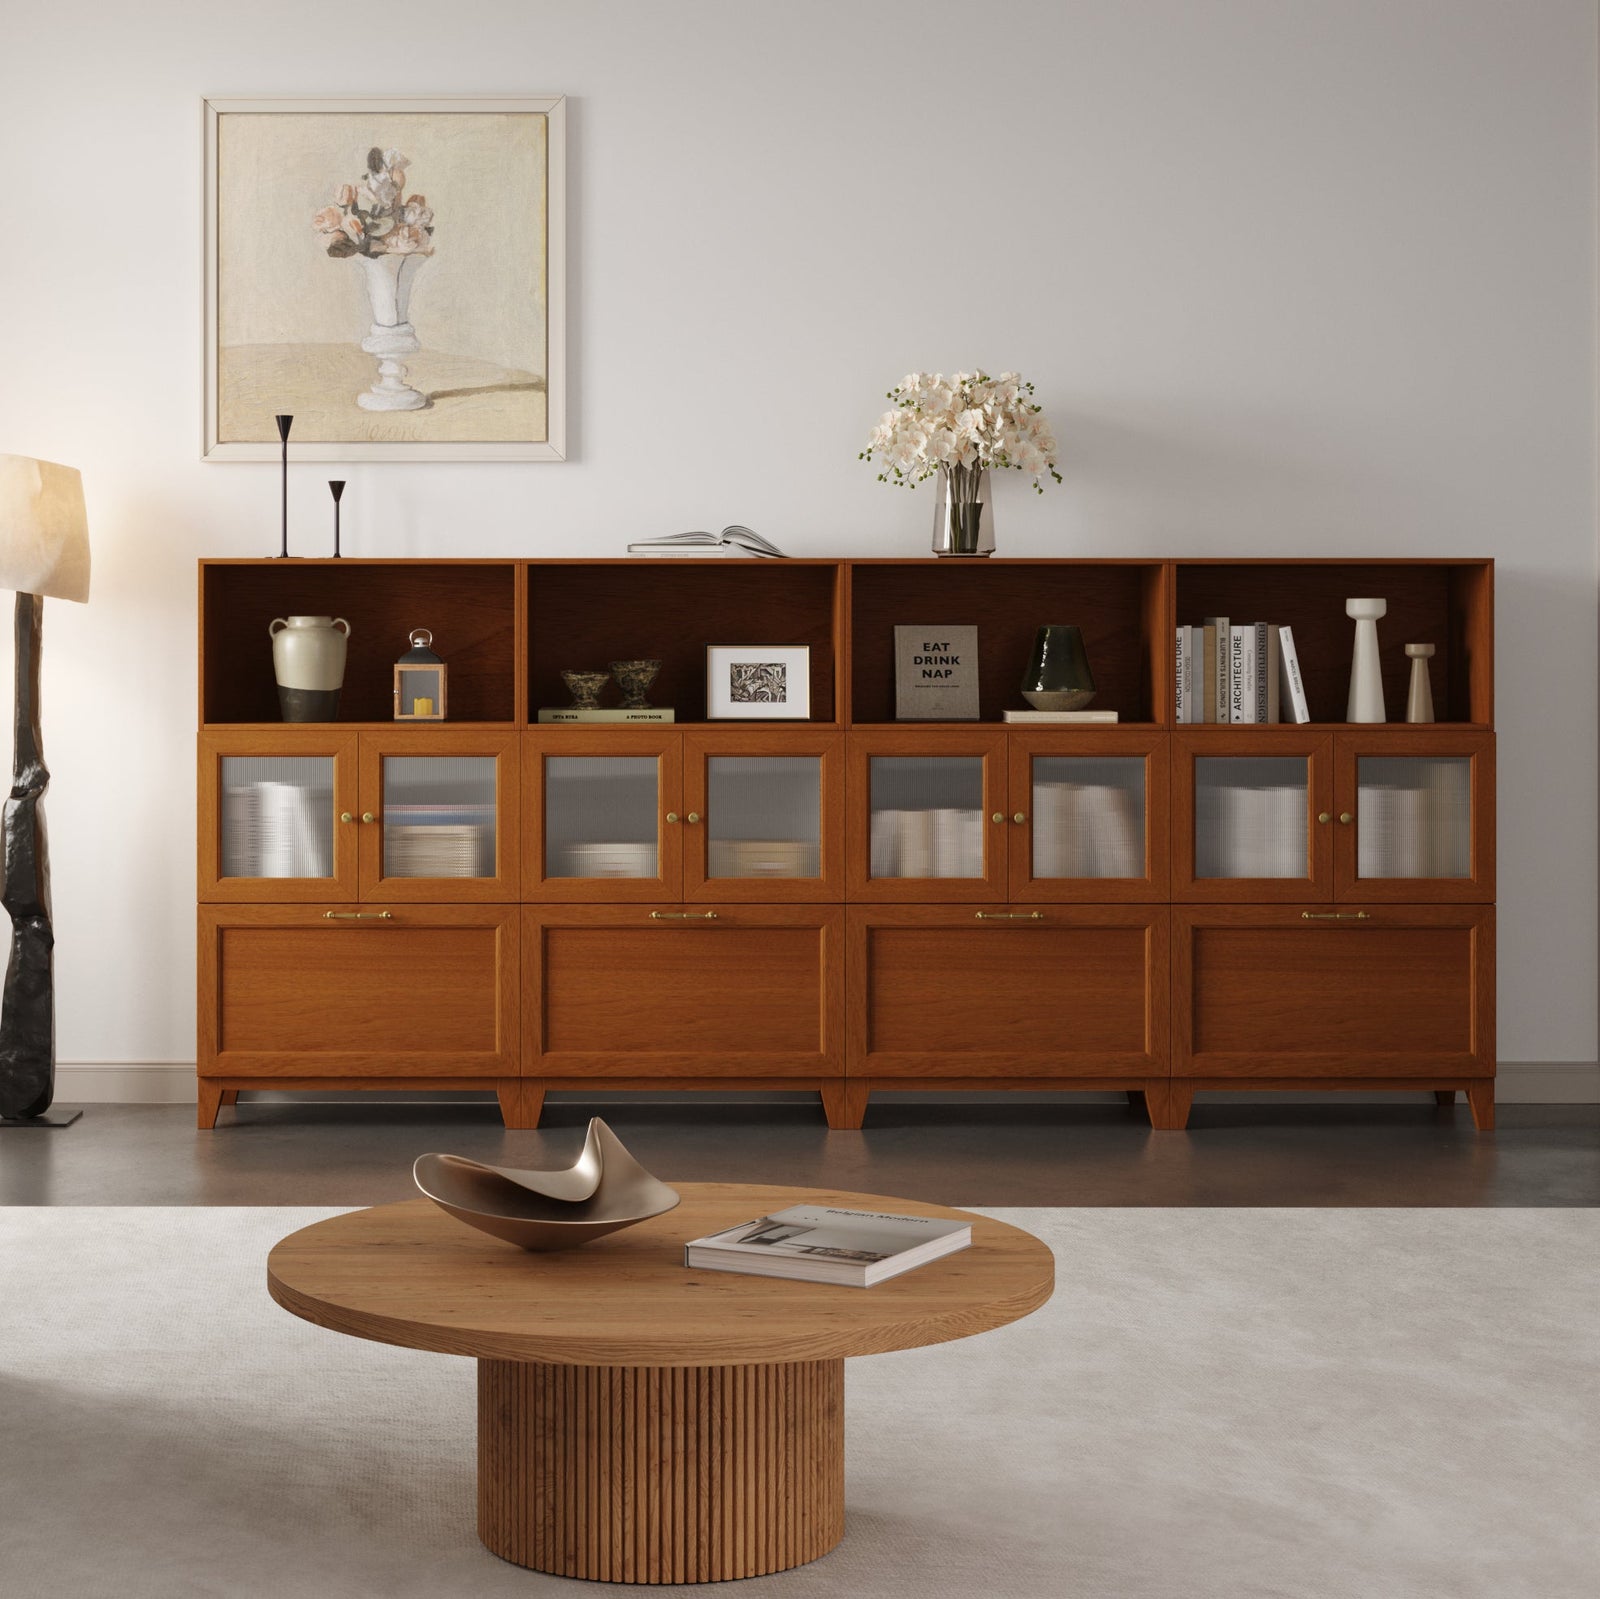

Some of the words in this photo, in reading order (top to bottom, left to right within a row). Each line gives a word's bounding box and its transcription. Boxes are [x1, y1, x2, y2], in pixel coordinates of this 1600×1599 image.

[923, 642, 950, 652] EAT
[913, 656, 960, 665] DRINK
[922, 669, 953, 678] NAP
[1233, 635, 1242, 711] ARCHITECTURE
